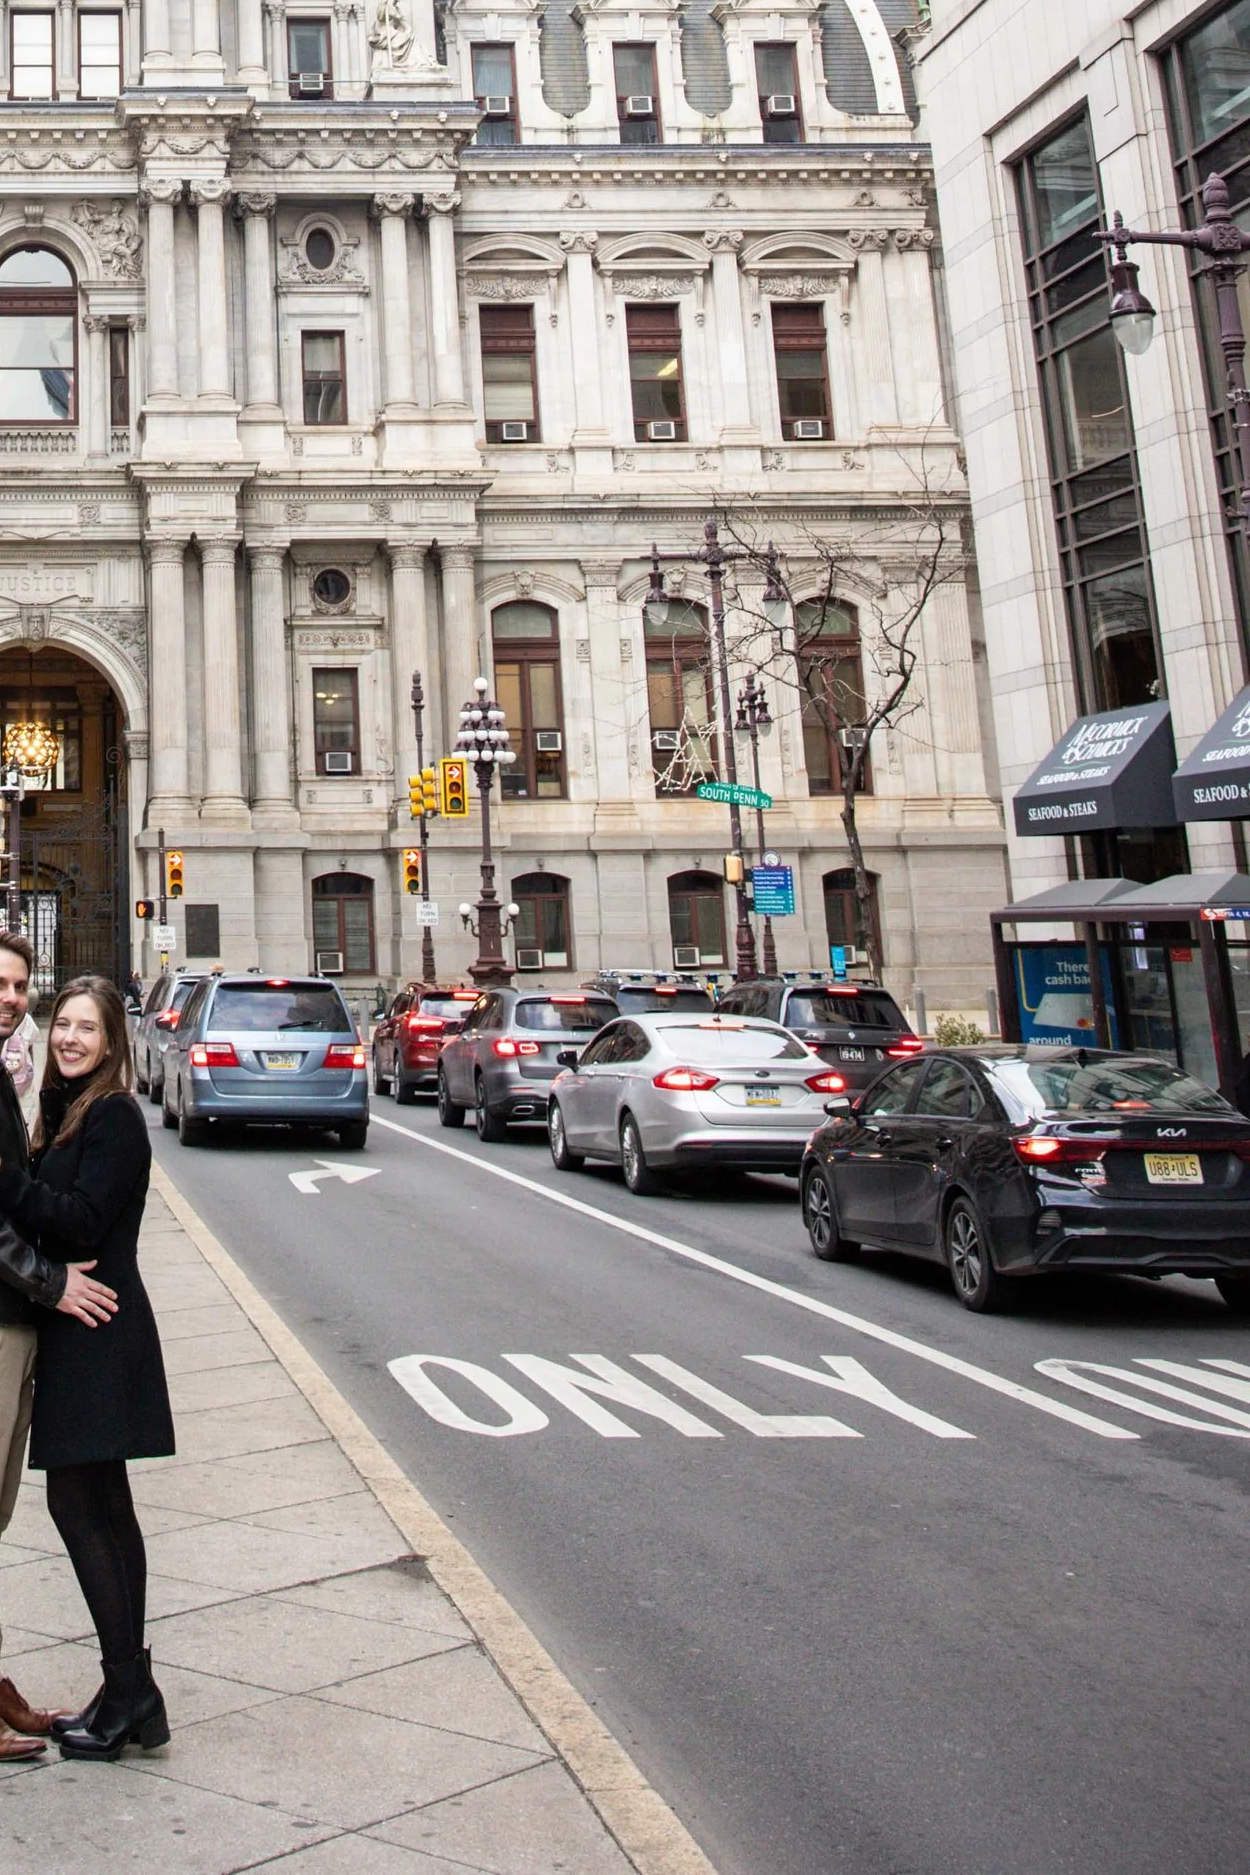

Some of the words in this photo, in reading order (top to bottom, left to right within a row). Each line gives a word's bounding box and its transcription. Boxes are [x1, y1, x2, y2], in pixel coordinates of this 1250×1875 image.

[700, 786, 730, 801] SOUTH
[734, 792, 758, 806] PENN
[760, 799, 770, 808] SQ
[1193, 785, 1239, 804] SEAFOOD
[1240, 787, 1248, 798] &
[1028, 804, 1062, 821] SEAFOOD
[1063, 808, 1069, 817] &
[1069, 800, 1098, 817] STEAKS
[1045, 974, 1072, 986] cash
[1073, 974, 1091, 986] bac
[1028, 1034, 1072, 1046] around
[1157, 1128, 1186, 1137] KIA
[386, 1352, 977, 1440] ONLY
